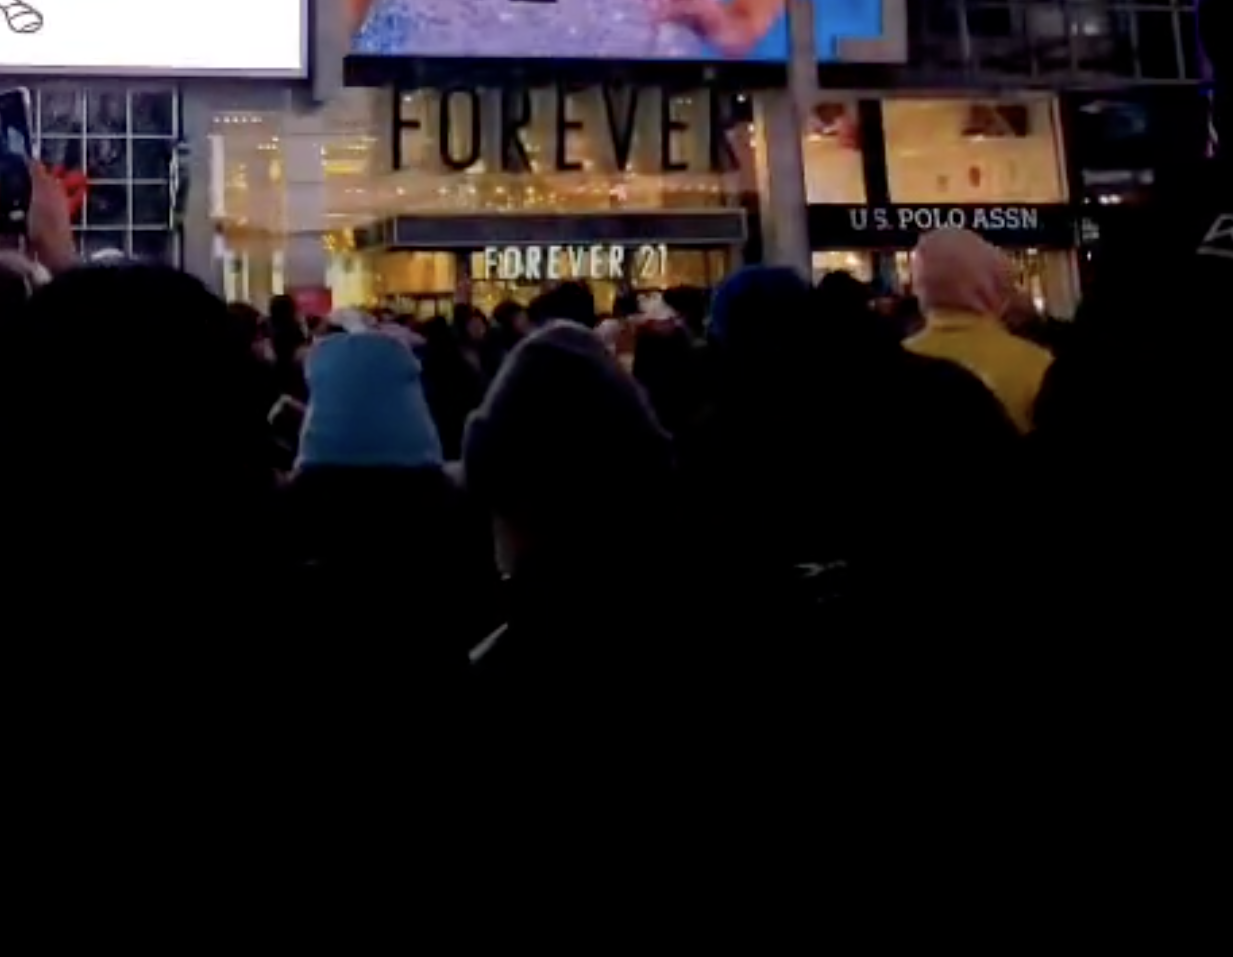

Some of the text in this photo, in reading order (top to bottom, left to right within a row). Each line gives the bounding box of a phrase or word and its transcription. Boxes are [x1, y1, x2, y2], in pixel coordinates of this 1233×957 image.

[391, 85, 740, 172] FOREVER
[898, 207, 966, 229] POLO
[484, 244, 668, 280] FOREVER 21
